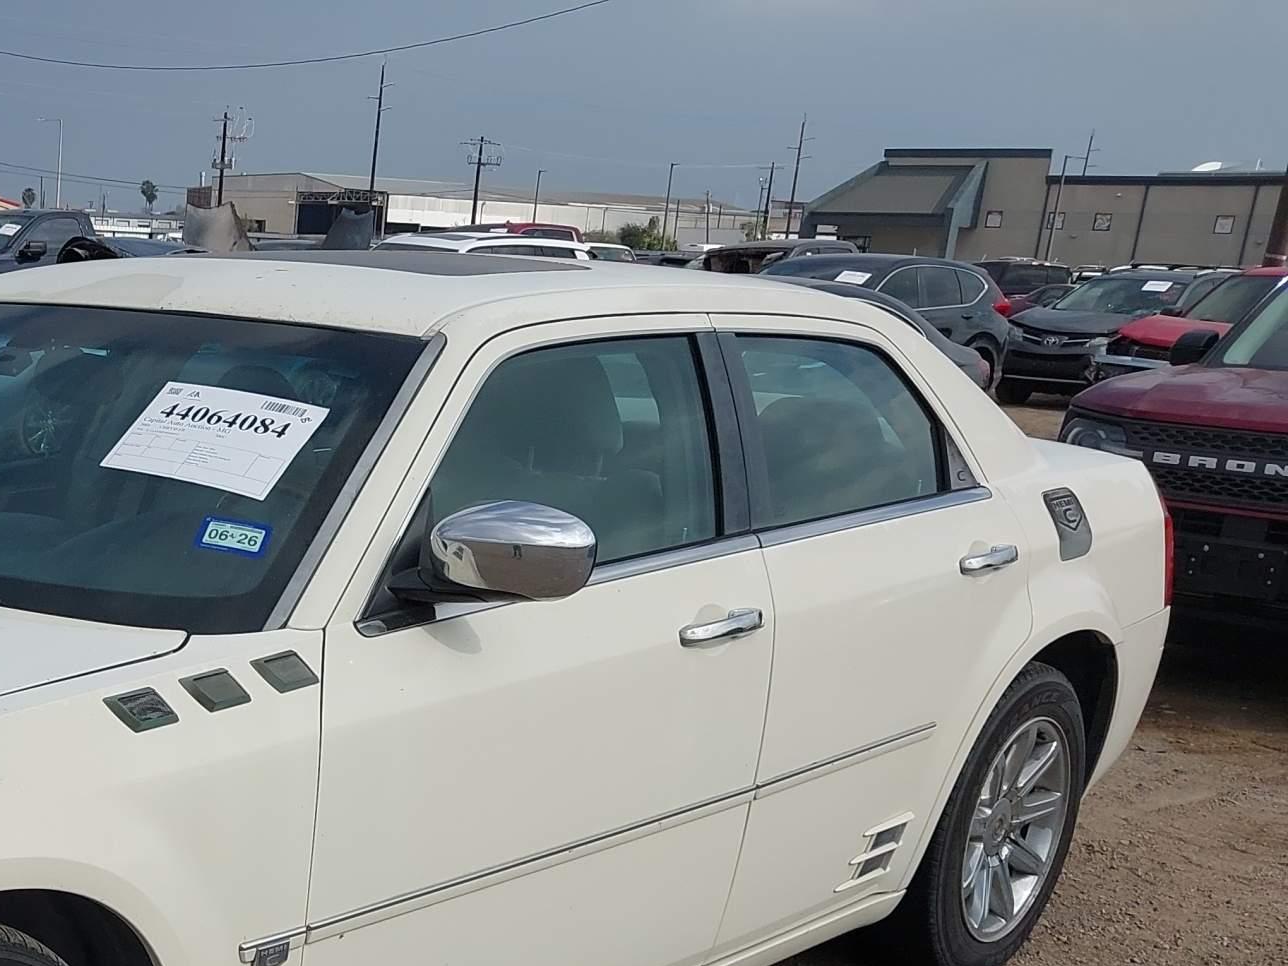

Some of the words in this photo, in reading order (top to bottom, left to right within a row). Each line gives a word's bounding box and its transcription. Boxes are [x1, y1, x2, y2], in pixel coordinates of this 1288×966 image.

[160, 403, 291, 438] 44064084
[208, 529, 229, 541] 06
[236, 533, 259, 546] 26
